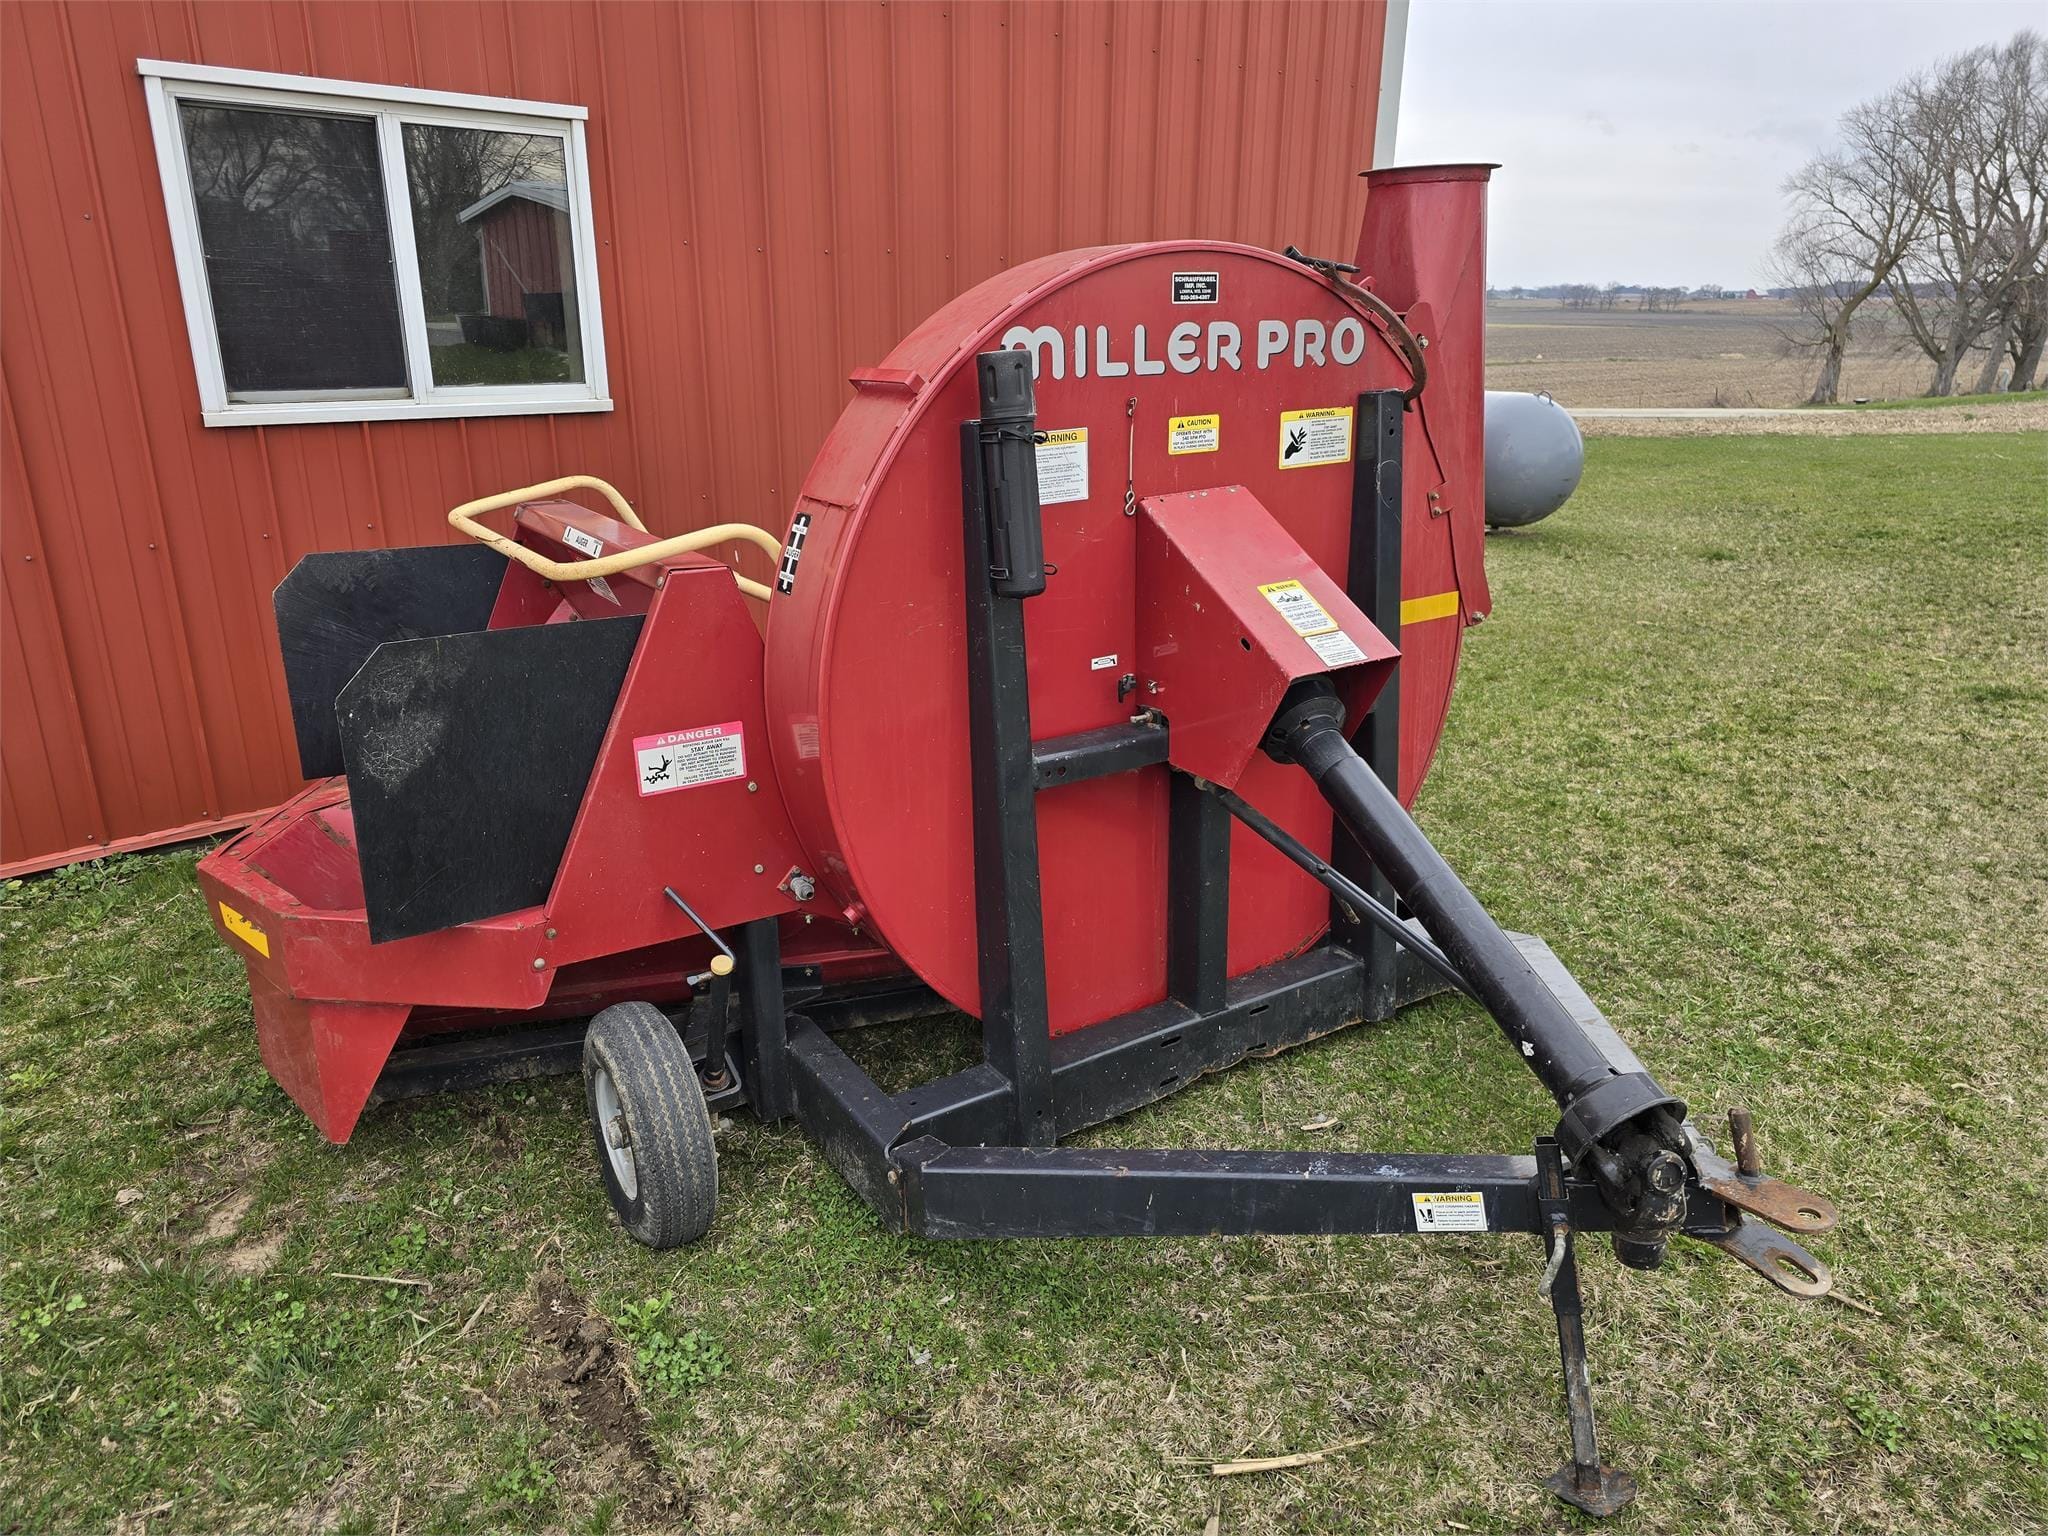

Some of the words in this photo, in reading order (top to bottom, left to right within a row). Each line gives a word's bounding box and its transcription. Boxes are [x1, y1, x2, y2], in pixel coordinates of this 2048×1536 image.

[1001, 321, 1242, 381] MILLER
[1257, 316, 1365, 370] PRO
[1046, 432, 1078, 444] ARNING
[786, 548, 800, 558] AUGER
[668, 728, 721, 743] DANGER
